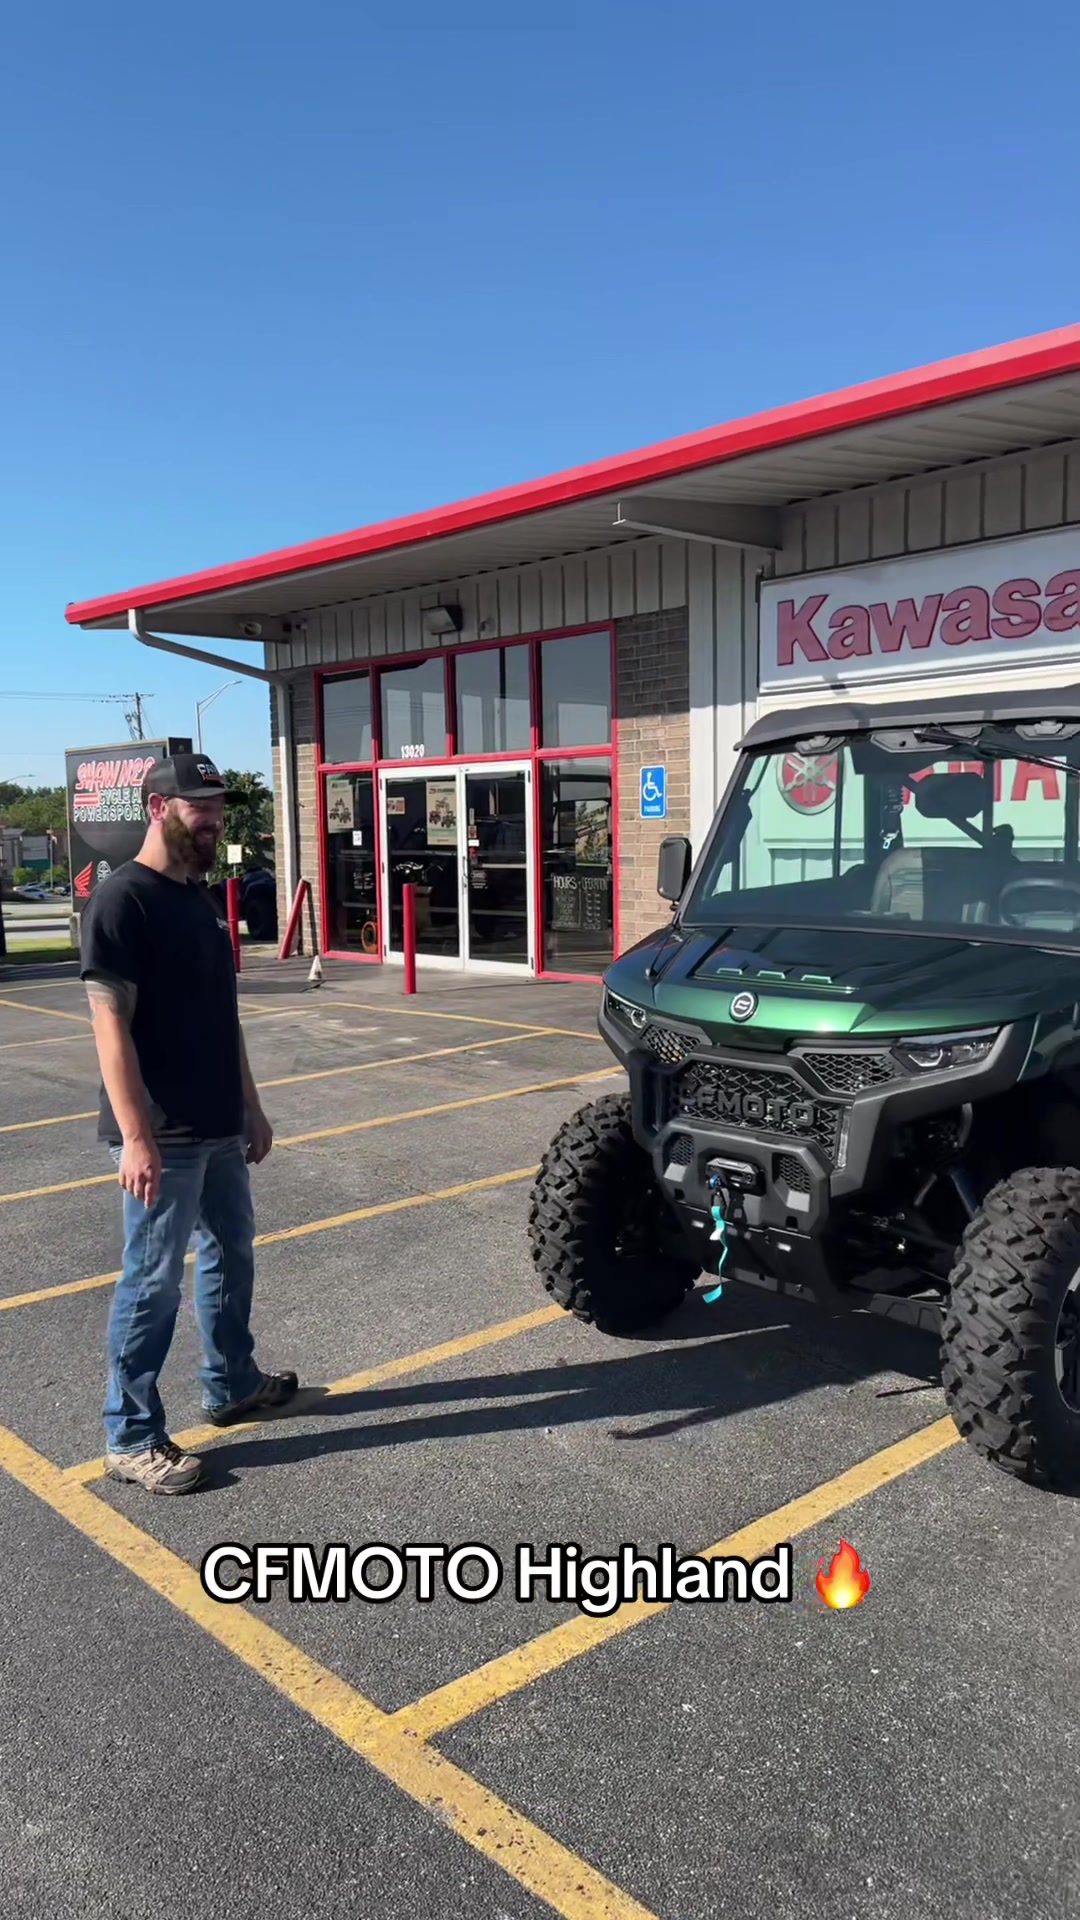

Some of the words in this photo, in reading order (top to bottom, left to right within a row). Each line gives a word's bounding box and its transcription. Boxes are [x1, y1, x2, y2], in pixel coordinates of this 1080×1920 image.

[777, 568, 1080, 667] Kawasa
[401, 744, 424, 759] 13020
[100, 788, 130, 804] CYCLE
[553, 876, 577, 890] HOURS
